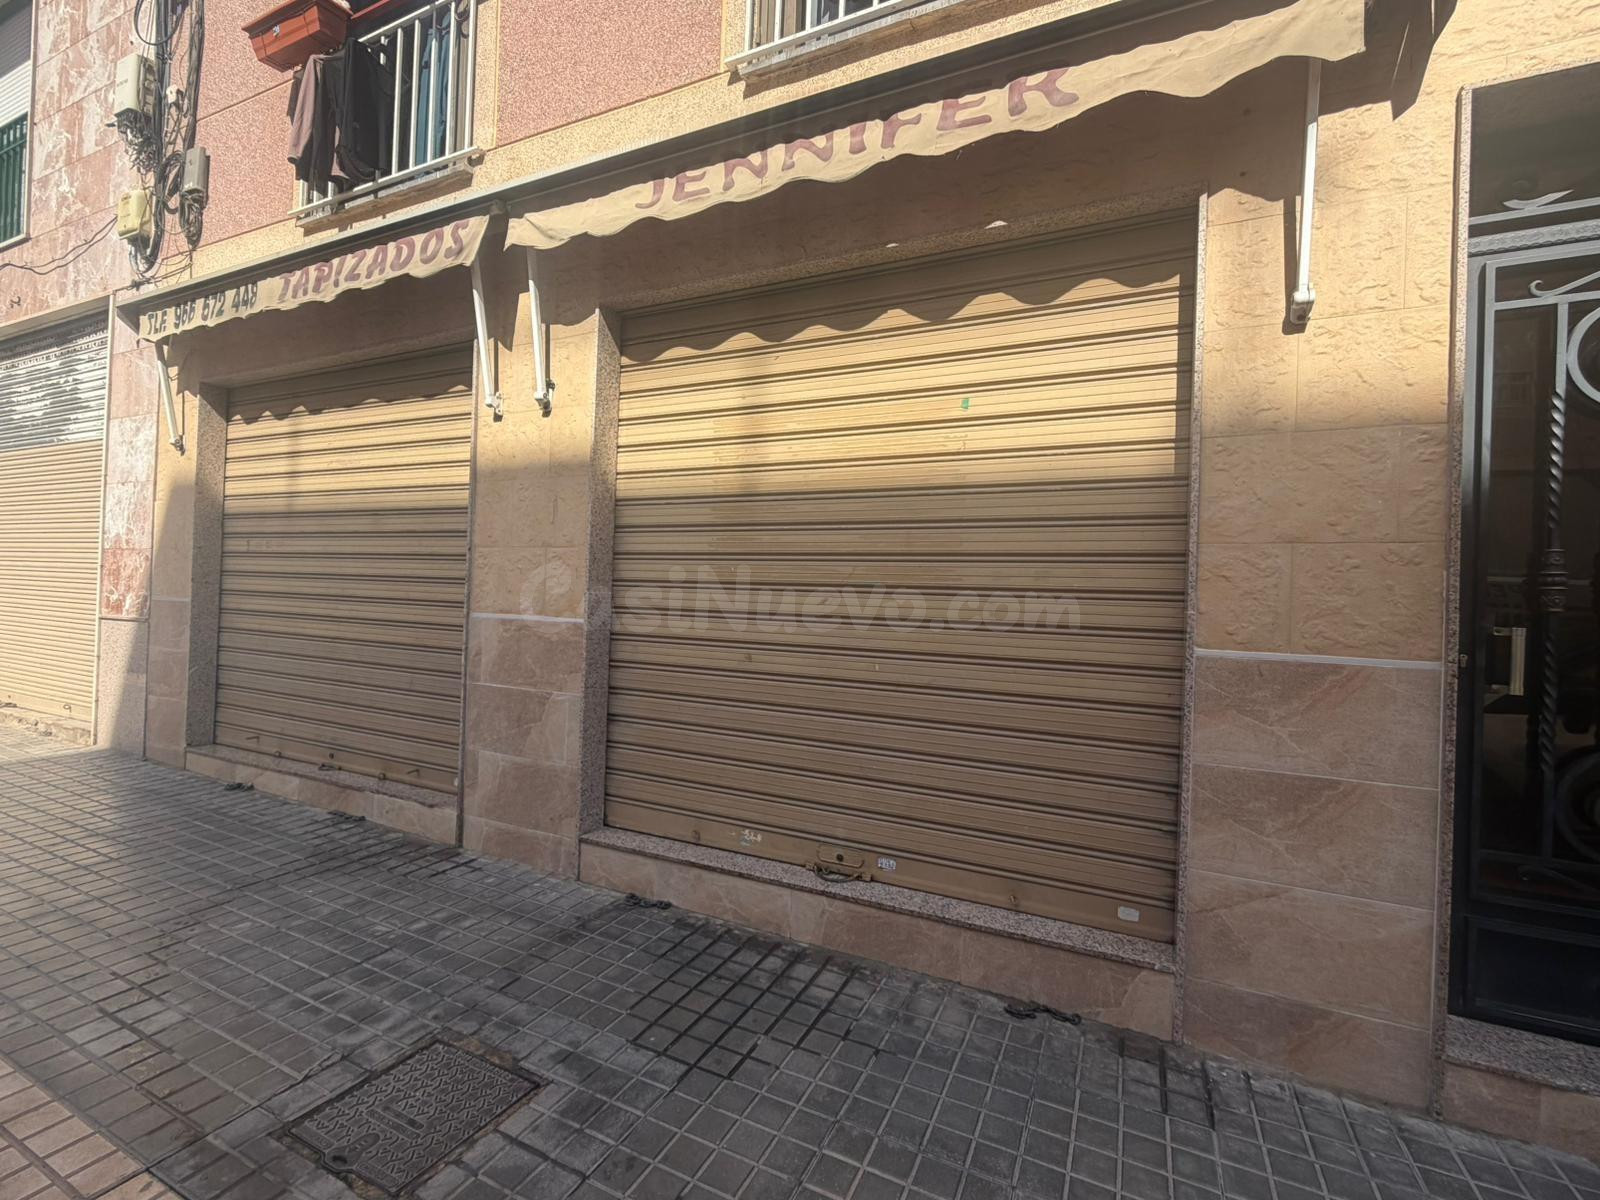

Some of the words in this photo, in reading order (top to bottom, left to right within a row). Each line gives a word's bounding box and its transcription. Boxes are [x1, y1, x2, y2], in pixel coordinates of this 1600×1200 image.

[635, 68, 1079, 209] JENNIFER
[174, 301, 198, 329] 966
[201, 291, 225, 321] 672
[277, 219, 470, 304] TAPIZADOS
